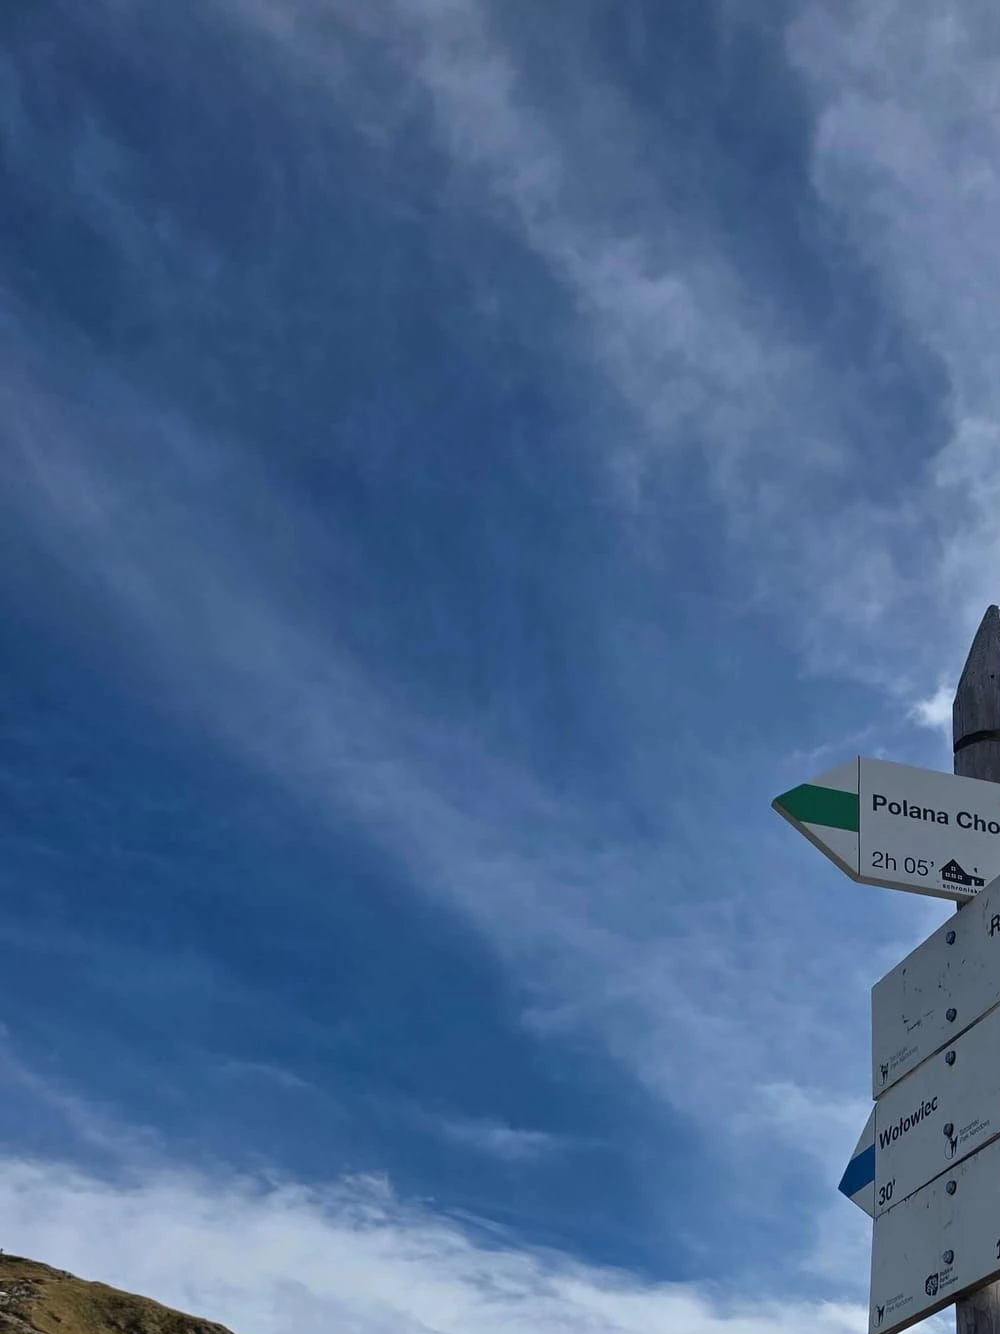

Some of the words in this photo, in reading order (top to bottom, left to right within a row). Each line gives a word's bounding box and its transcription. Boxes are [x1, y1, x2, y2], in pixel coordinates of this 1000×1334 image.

[872, 793, 949, 825] Polana
[872, 851, 896, 871] 2h
[879, 1096, 938, 1150] Wołowiec
[878, 1178, 896, 1206] 30'
